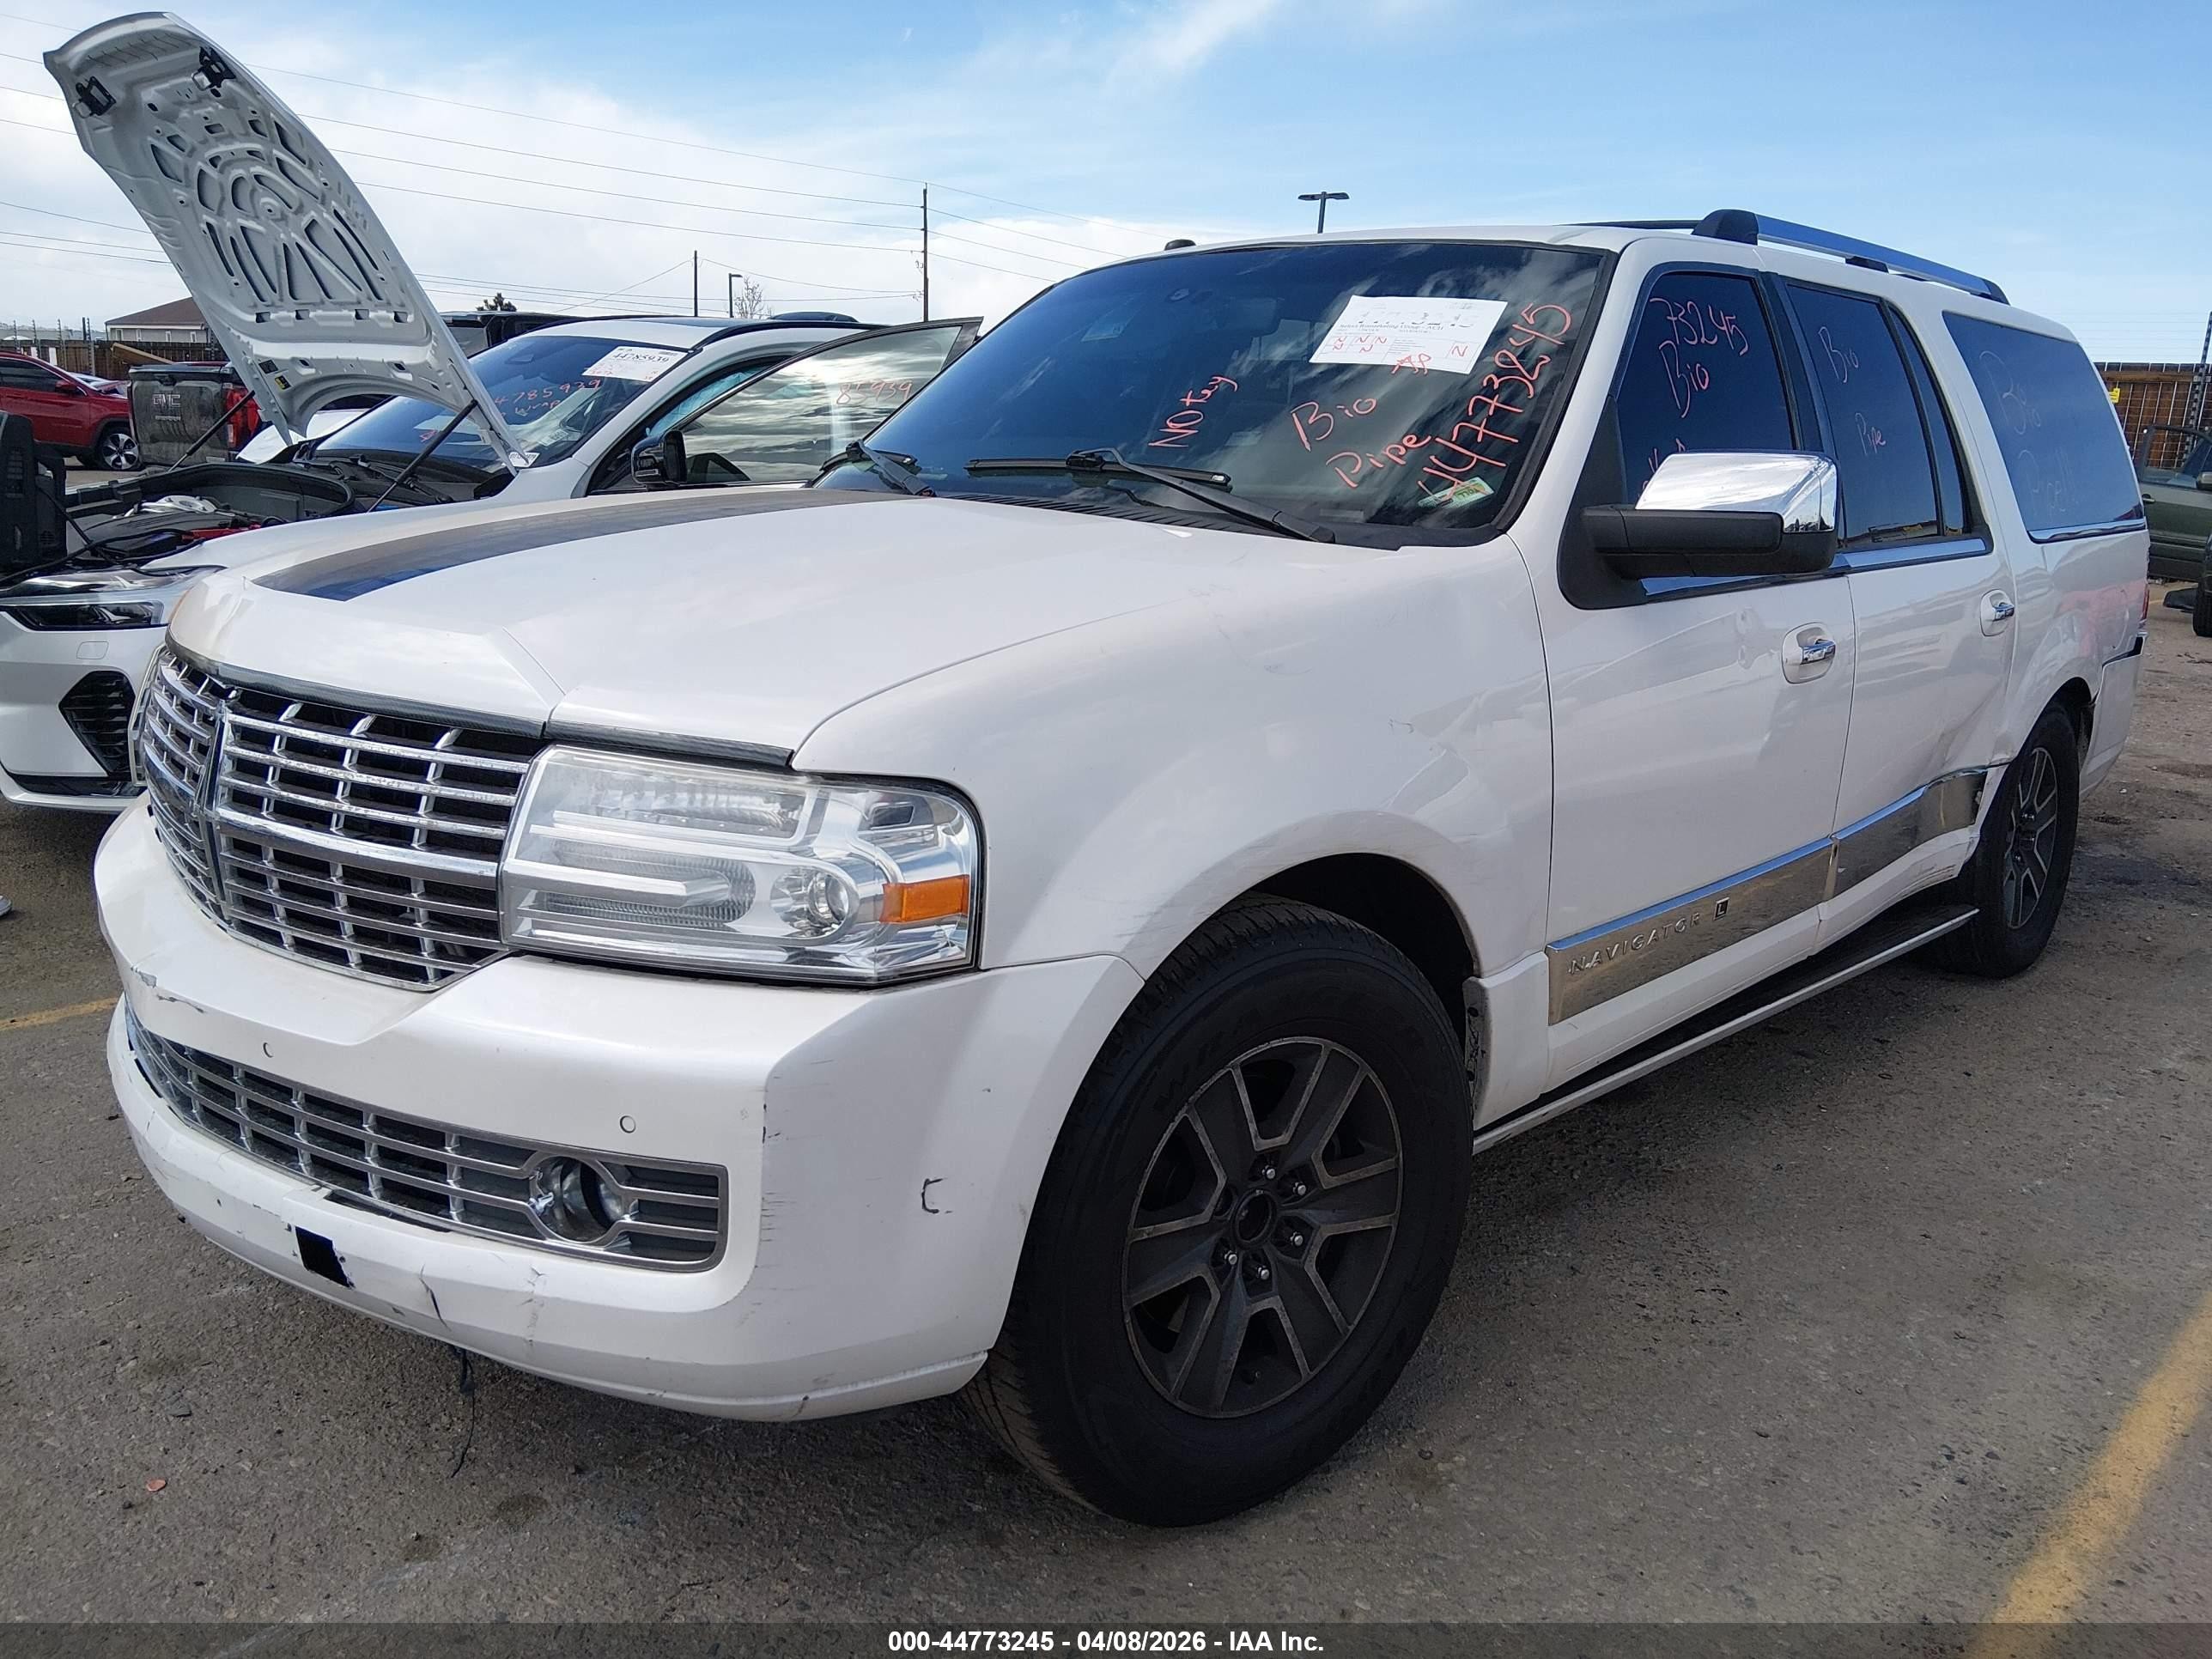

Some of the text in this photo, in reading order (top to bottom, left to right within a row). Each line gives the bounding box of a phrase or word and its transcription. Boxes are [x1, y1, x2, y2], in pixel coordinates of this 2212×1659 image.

[1649, 298, 1749, 356] 73245
[153, 393, 181, 406] GMC
[1417, 302, 1571, 503] 44773245
[1658, 340, 1710, 419] Bio
[1290, 400, 1377, 453] Bio
[1326, 433, 1432, 489] Pipe
[1568, 912, 1700, 975] NAVIGATOR
